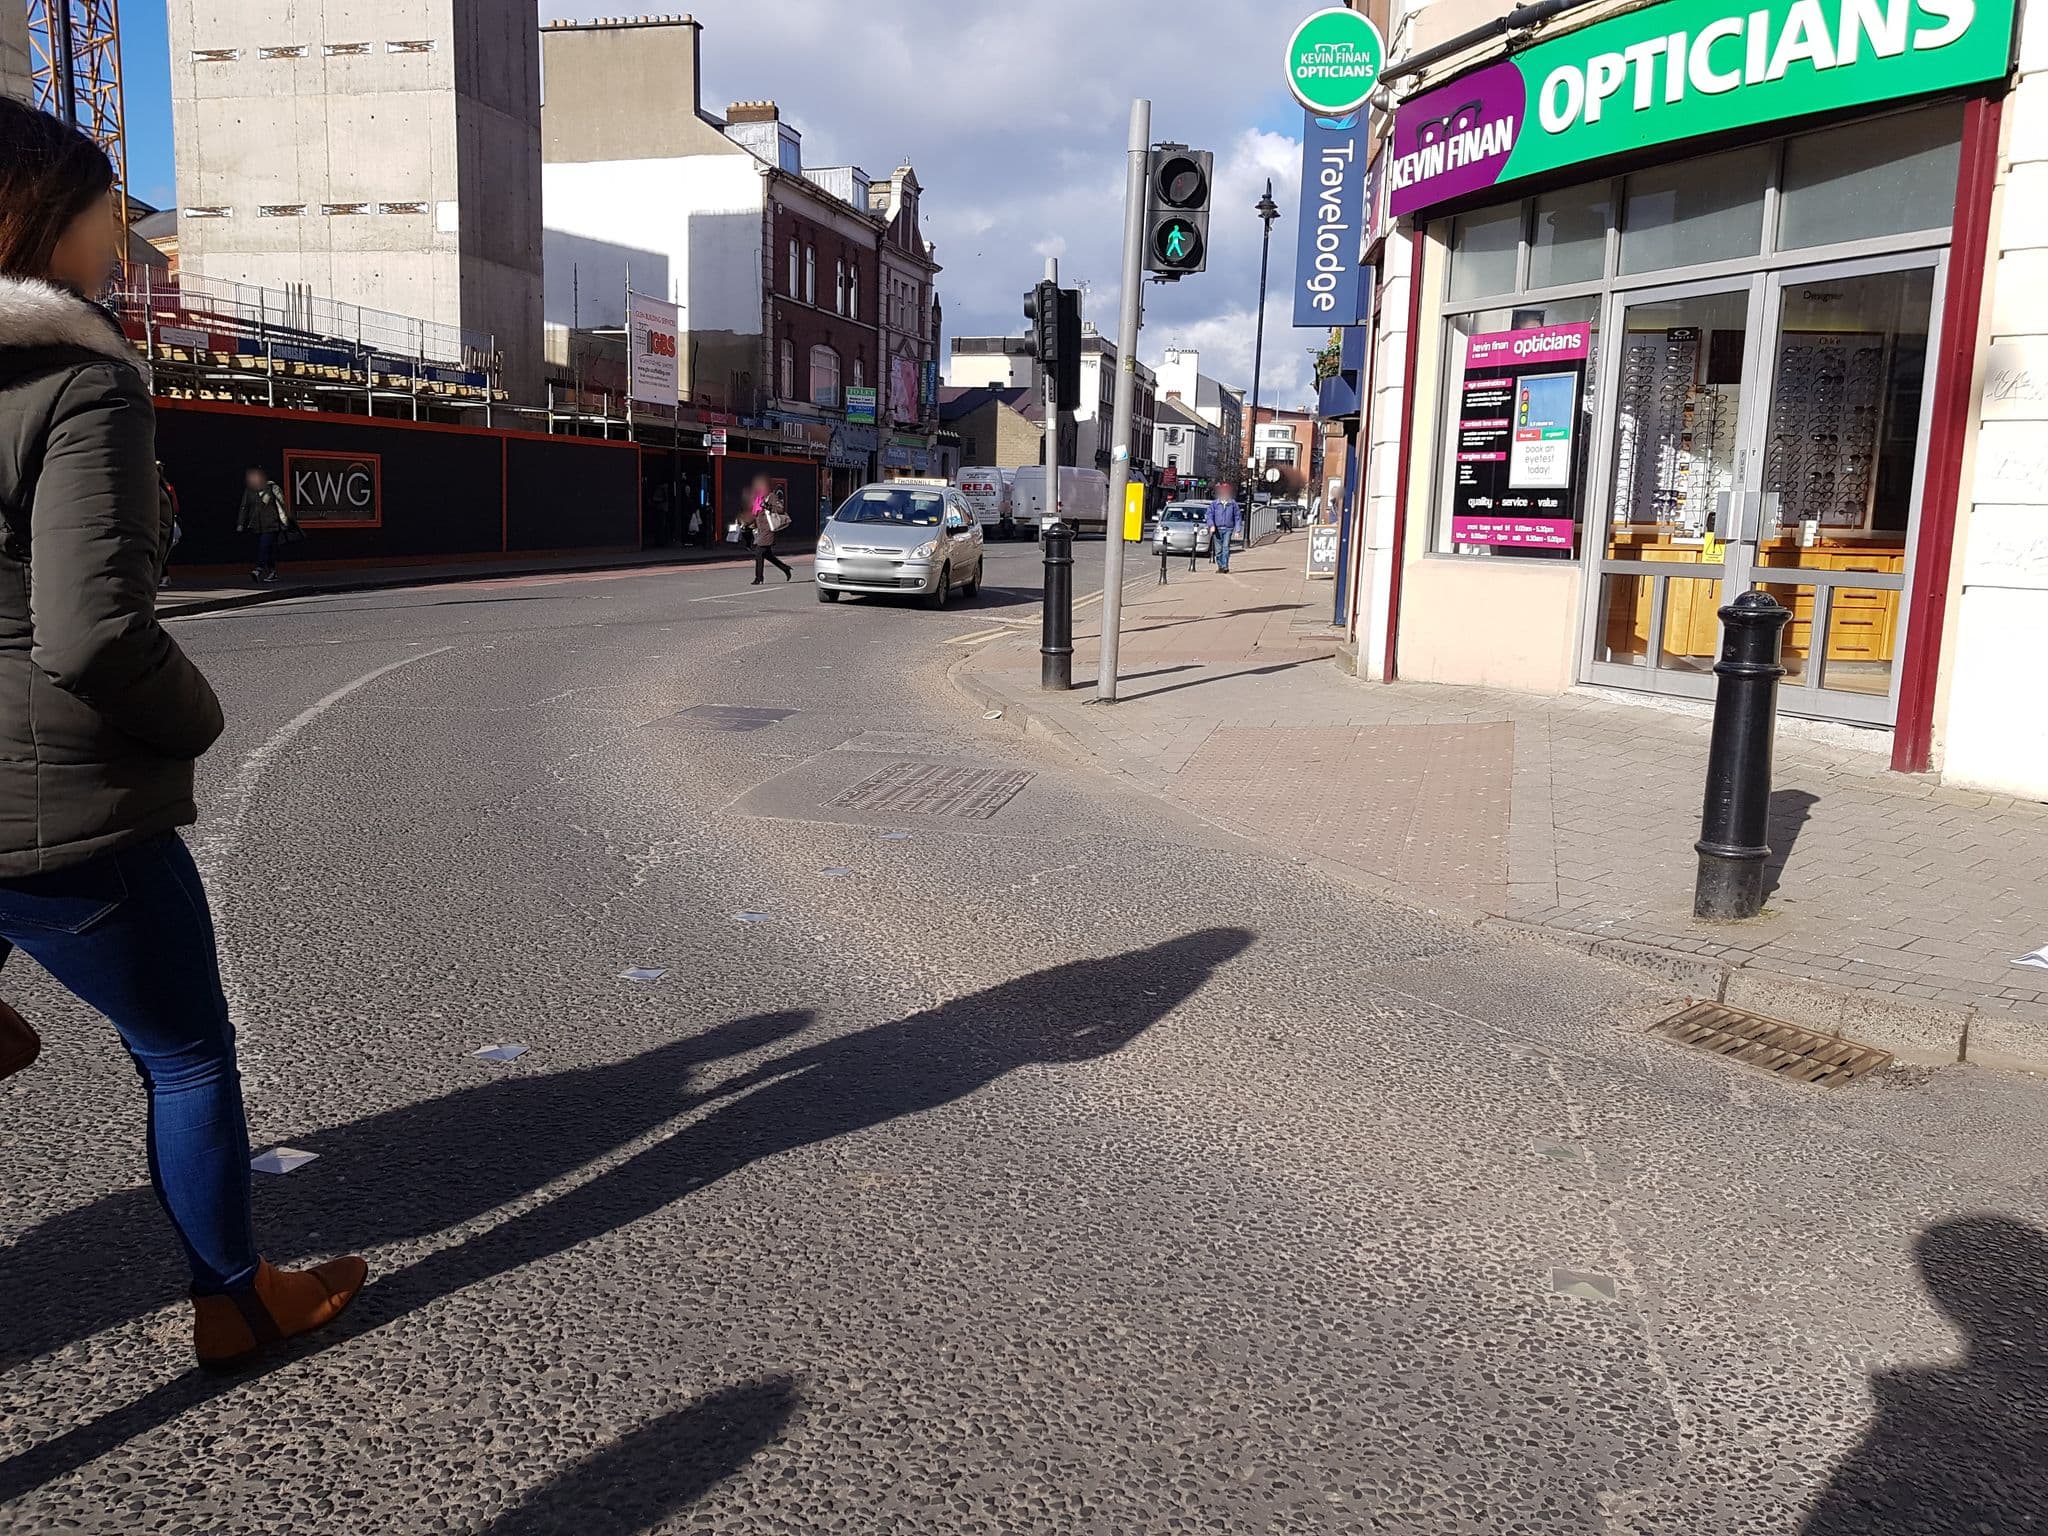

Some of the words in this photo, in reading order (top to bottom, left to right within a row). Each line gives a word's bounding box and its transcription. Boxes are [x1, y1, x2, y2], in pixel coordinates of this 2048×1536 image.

[1301, 51, 1333, 64] KEVIN
[1336, 51, 1370, 63] FINAN
[1297, 64, 1374, 78] OPTICIANS
[1537, 0, 1975, 135] OPTICIANS
[1391, 132, 1445, 191] KEVIN
[1447, 115, 1513, 171] FINAN
[1306, 139, 1354, 312] Travelodge
[1473, 343, 1490, 353] kevin
[1513, 332, 1581, 357] opticians
[1525, 455, 1554, 465] eyetest
[296, 471, 371, 506] KWG
[962, 483, 993, 491] REA
[1468, 497, 1493, 509] quality
[1501, 497, 1528, 507] service
[1538, 497, 1558, 508] value
[1313, 549, 1336, 562] OPE
